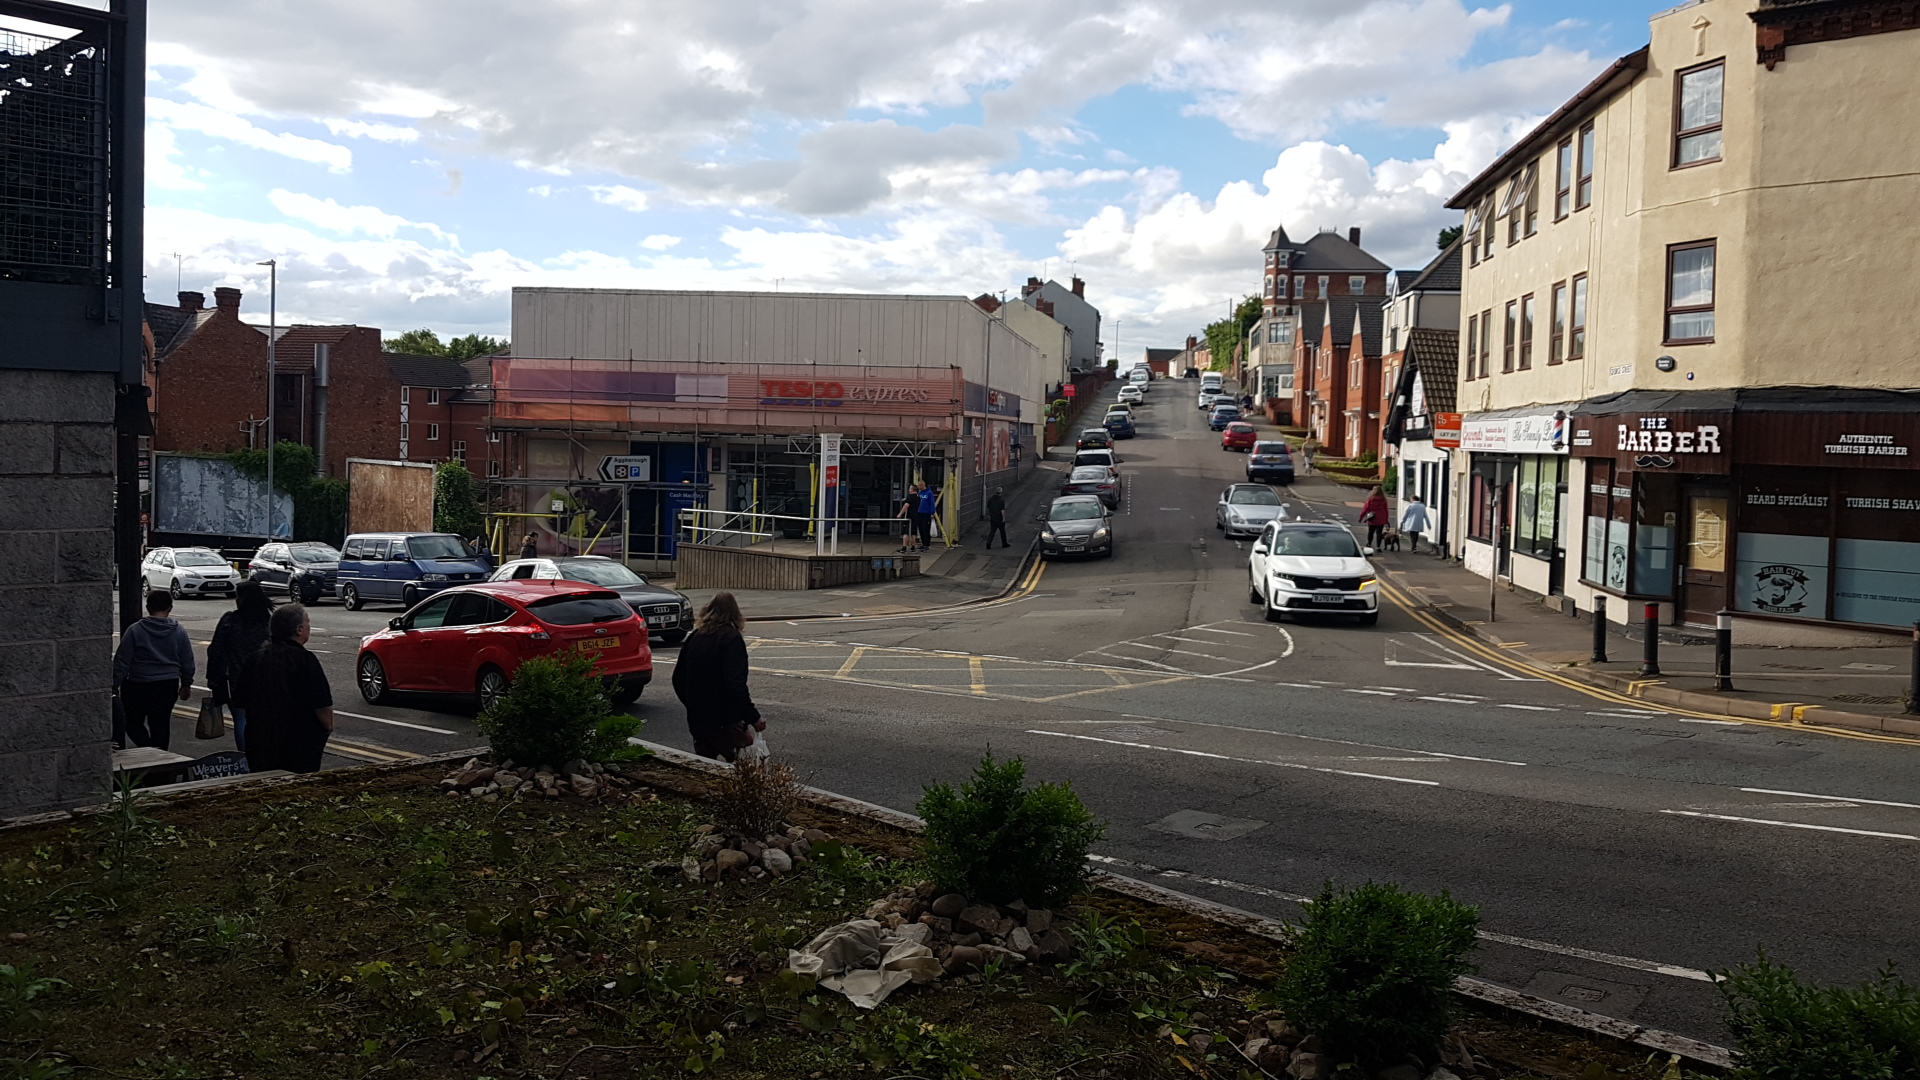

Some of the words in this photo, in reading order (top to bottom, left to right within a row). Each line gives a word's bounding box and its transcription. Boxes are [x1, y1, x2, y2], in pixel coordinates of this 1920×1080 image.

[761, 380, 844, 398] TESCO
[849, 385, 929, 405] express
[1640, 418, 1667, 429] THE
[1618, 424, 1721, 453] BARBER
[1839, 434, 1894, 444] AUTHENTIC
[1825, 445, 1866, 454] TURKISH
[1868, 446, 1908, 456] BARBER
[631, 467, 639, 476] P
[1747, 494, 1776, 505] BEARD
[1778, 495, 1828, 507] SPECIALIST
[1846, 497, 1890, 509] TURKISH
[1763, 567, 1784, 575] HAIR
[1785, 568, 1802, 577] CUT
[582, 640, 599, 649] BG14
[601, 638, 615, 647] JZF
[192, 762, 239, 775] Weavers
